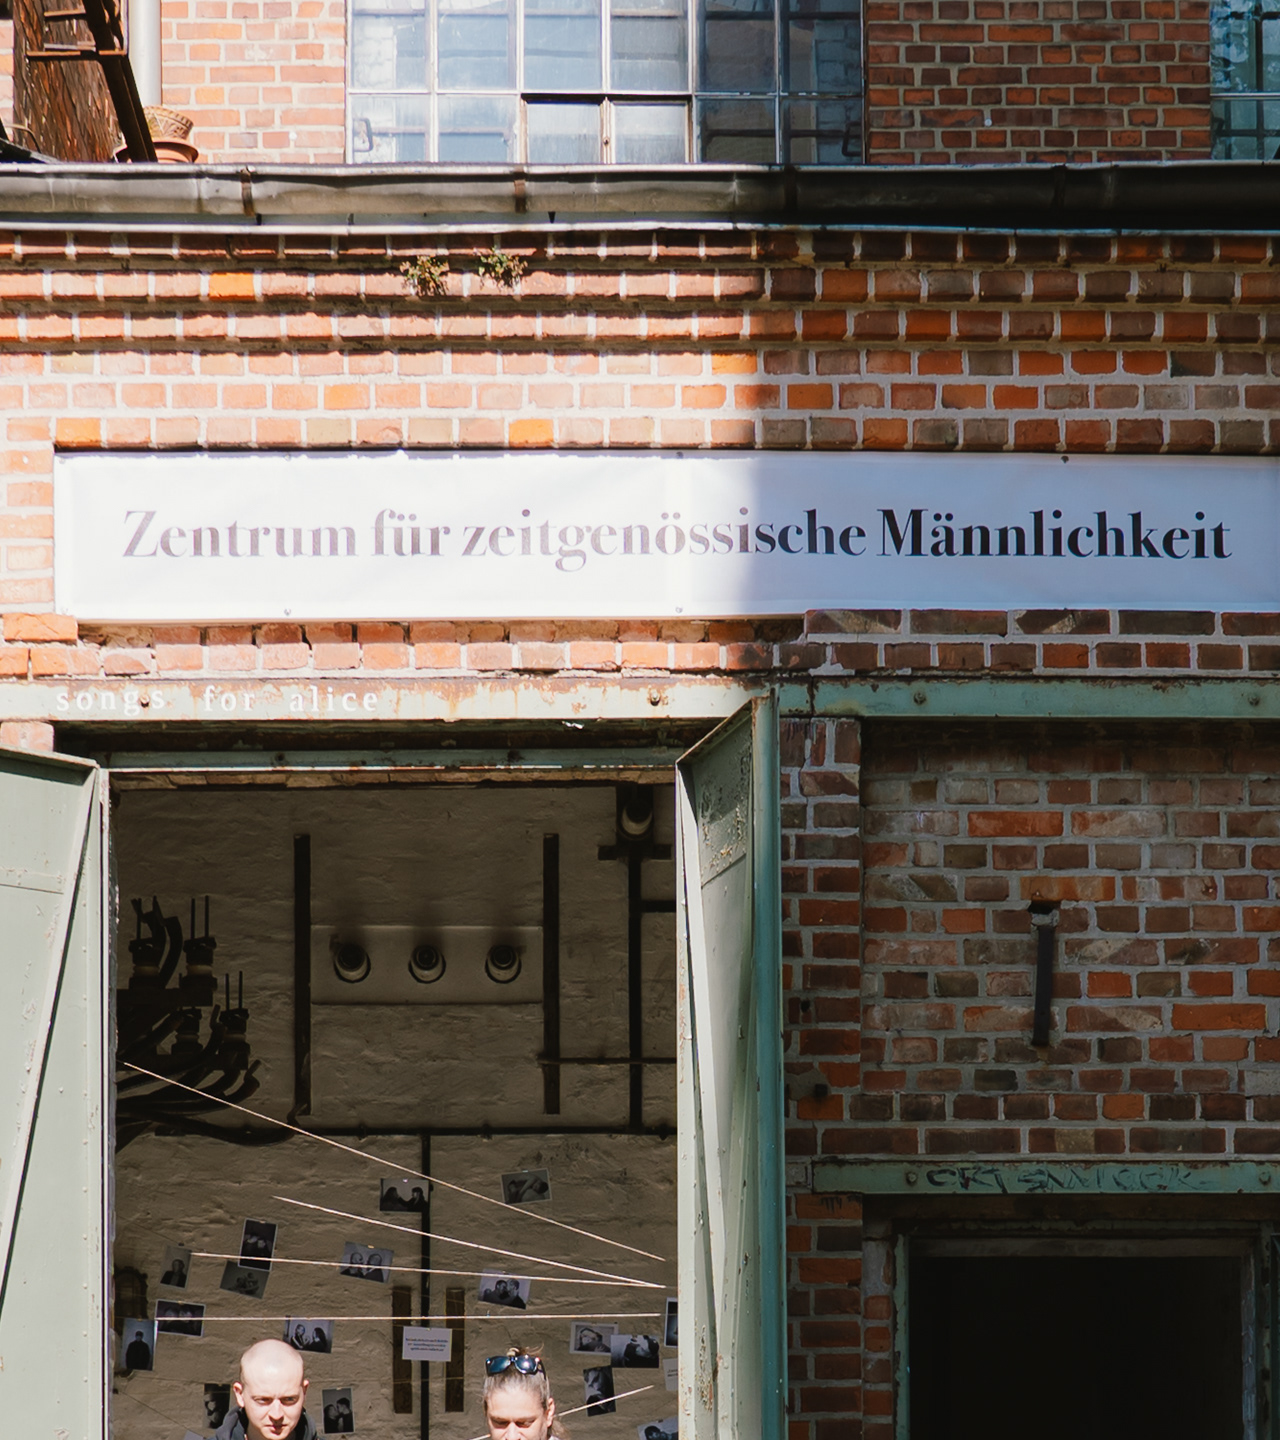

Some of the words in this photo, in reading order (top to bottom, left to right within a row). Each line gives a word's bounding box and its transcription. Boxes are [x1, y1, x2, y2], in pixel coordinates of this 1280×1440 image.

[122, 509, 359, 561] Zentrum
[373, 509, 451, 561] für
[462, 507, 867, 573] zeitgenössische
[876, 507, 1233, 562] Männlichkeit
[56, 687, 166, 716] songs
[203, 685, 256, 712] for
[289, 685, 378, 712] alice
